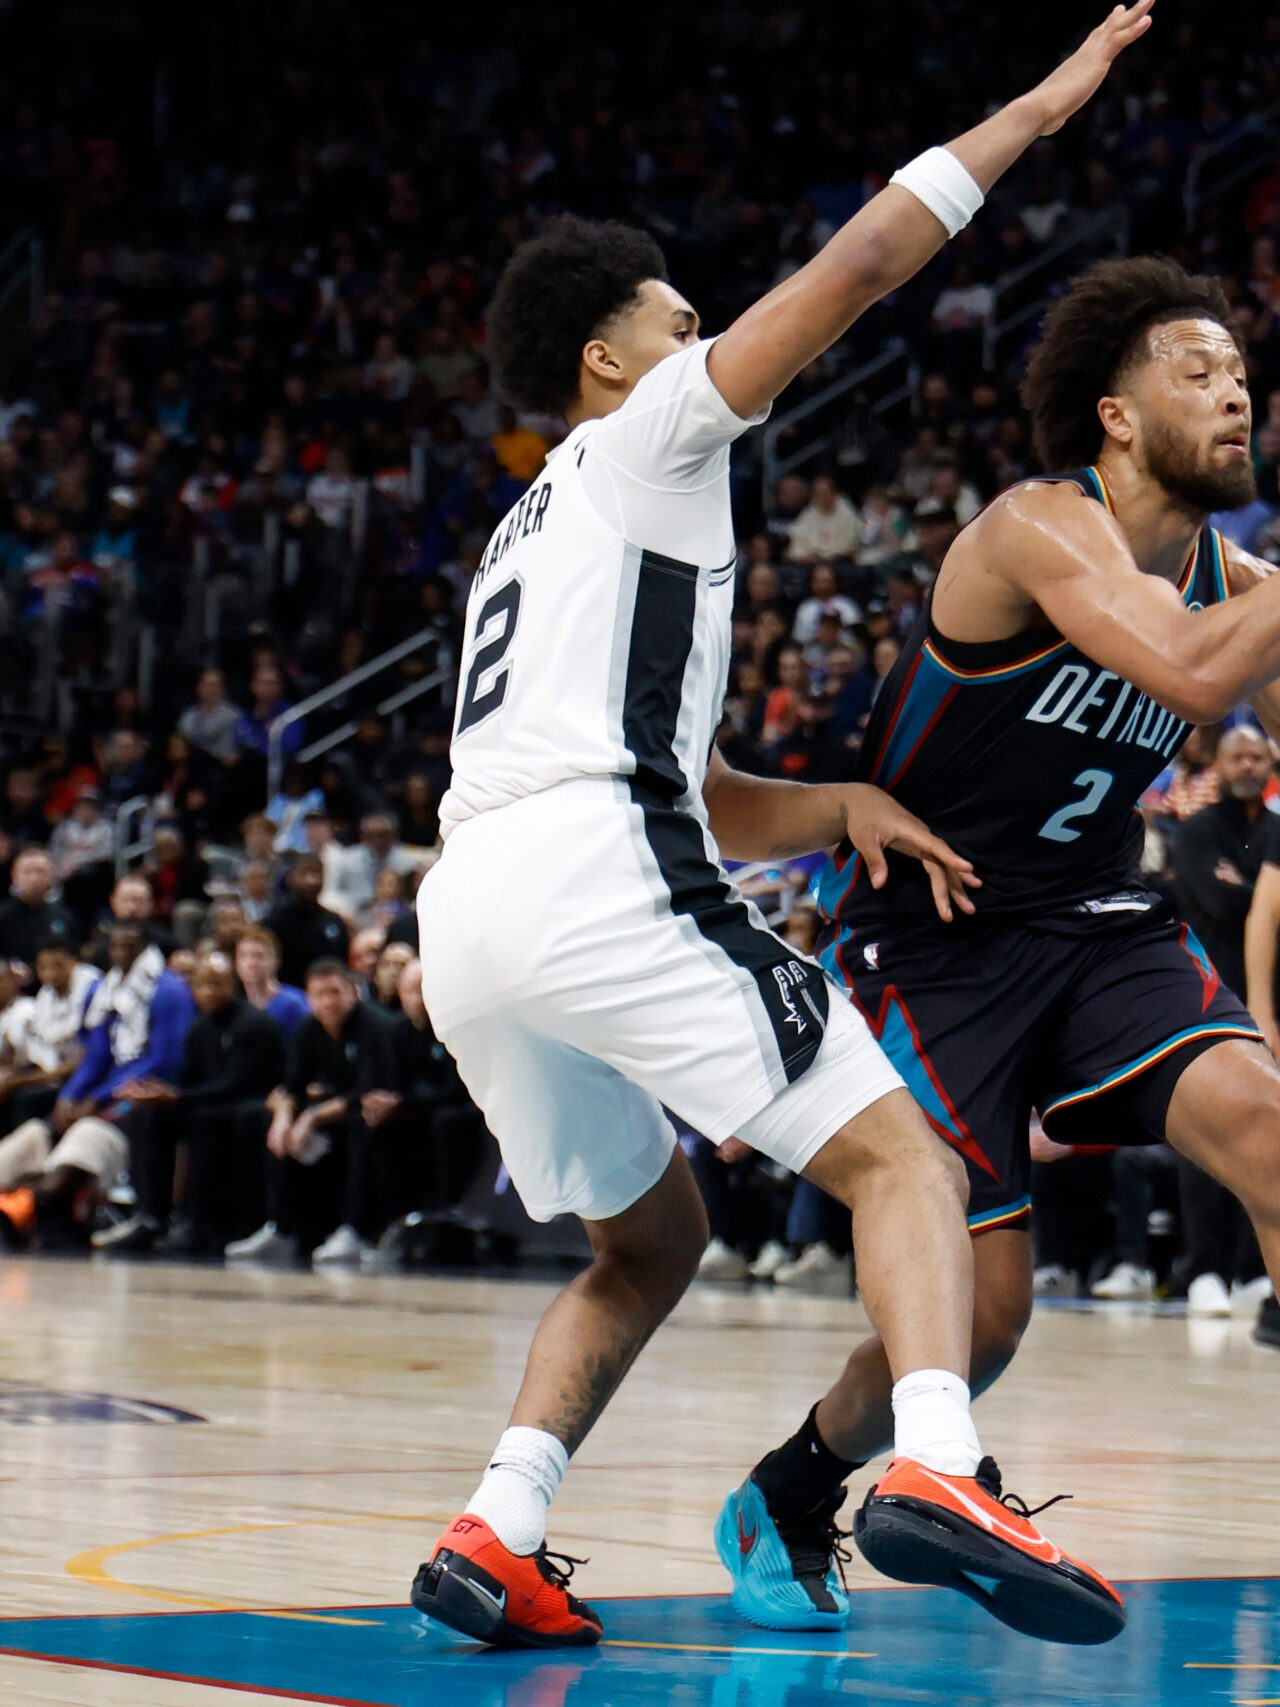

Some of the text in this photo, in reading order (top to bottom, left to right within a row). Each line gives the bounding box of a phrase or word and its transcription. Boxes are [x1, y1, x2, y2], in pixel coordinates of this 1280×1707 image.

[475, 482, 552, 594] HARPER
[456, 573, 525, 740] 2
[1037, 769, 1114, 843] 2
[452, 1519, 484, 1535] GT
